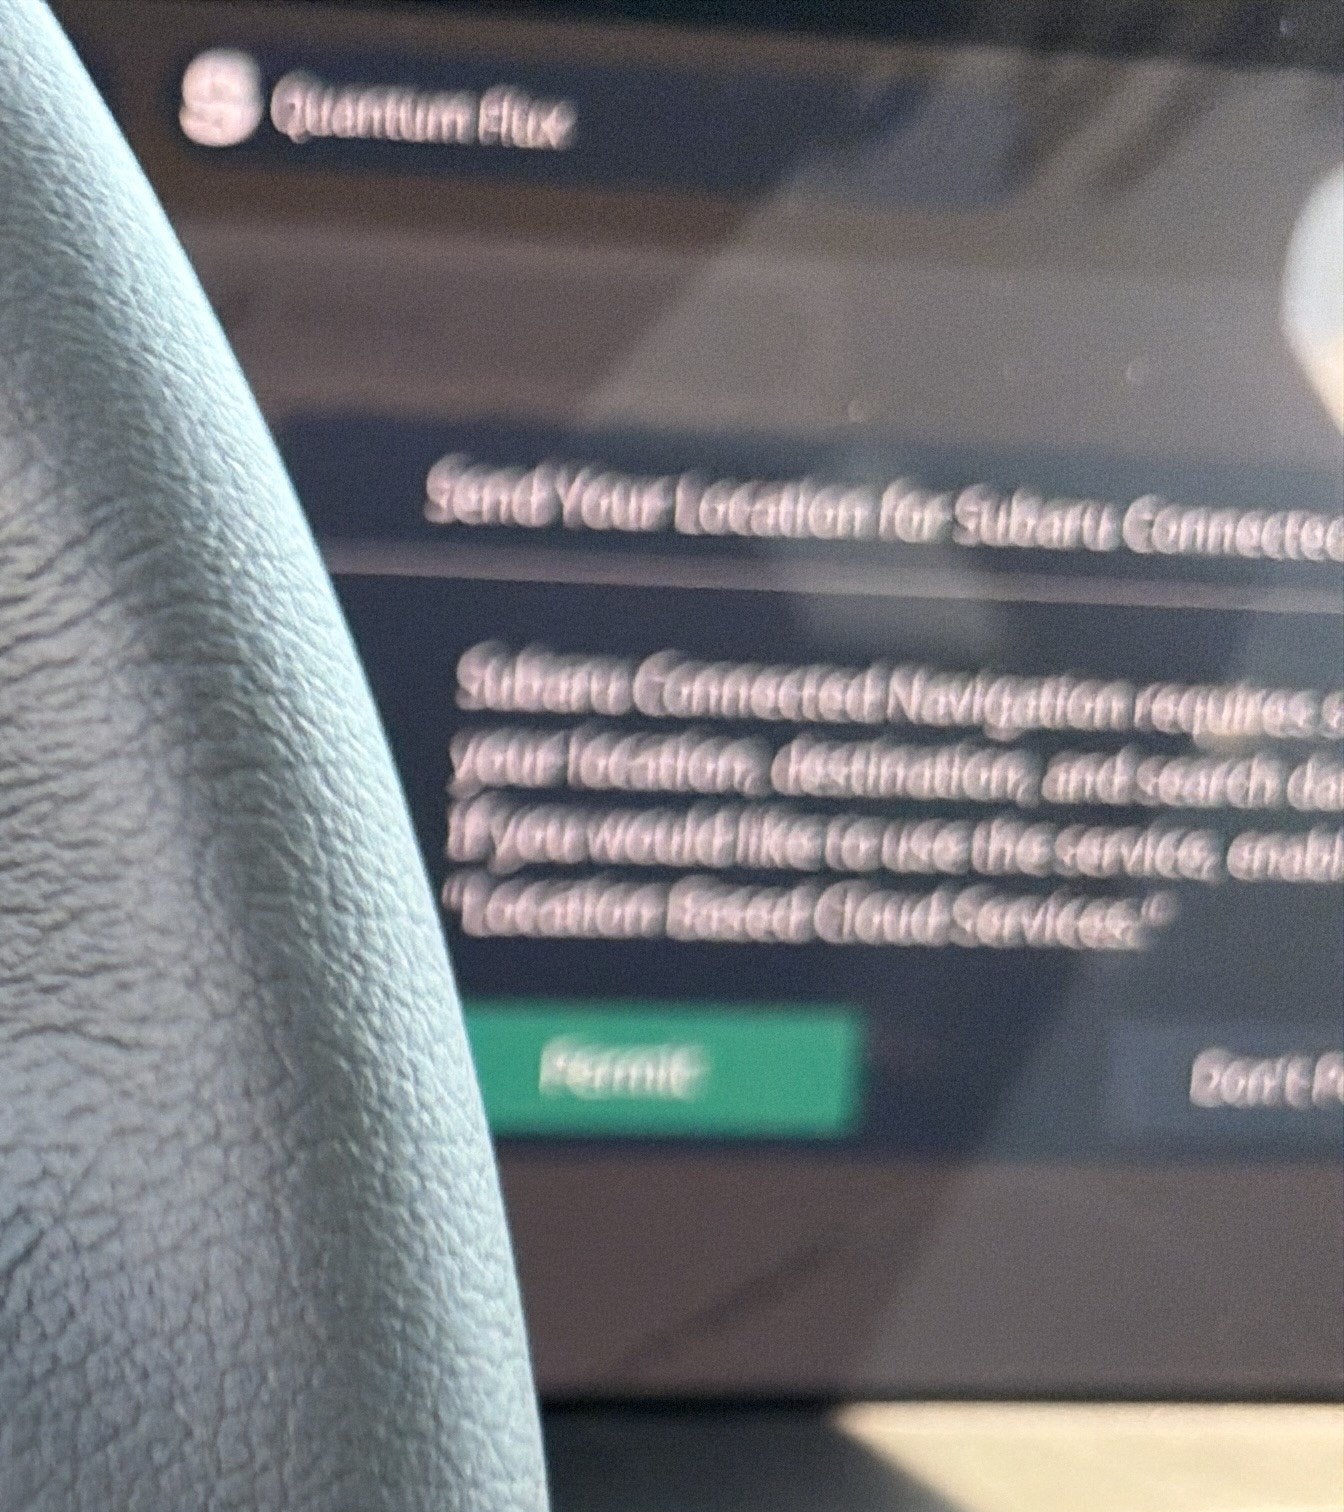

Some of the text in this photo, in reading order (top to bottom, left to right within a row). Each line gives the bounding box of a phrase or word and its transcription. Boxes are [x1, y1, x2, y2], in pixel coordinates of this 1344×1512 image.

[270, 72, 476, 146] Quantum
[424, 456, 555, 528] Send
[555, 465, 674, 532] Your
[675, 471, 874, 540] Location
[879, 480, 952, 544] for
[953, 486, 1115, 552] Subaru
[456, 642, 633, 715] Subaru
[633, 650, 886, 723] Connected
[886, 664, 1133, 740] Navigation
[448, 730, 568, 799] your
[1042, 747, 1138, 804] and
[1136, 752, 1283, 810] search
[489, 797, 587, 874] you
[588, 802, 734, 868] would
[737, 805, 824, 870] like
[825, 812, 882, 872] to
[882, 816, 971, 876] use
[972, 817, 1055, 878] the
[666, 876, 815, 943] Based
[814, 880, 954, 947] Cloud
[538, 1035, 704, 1101] Permit
